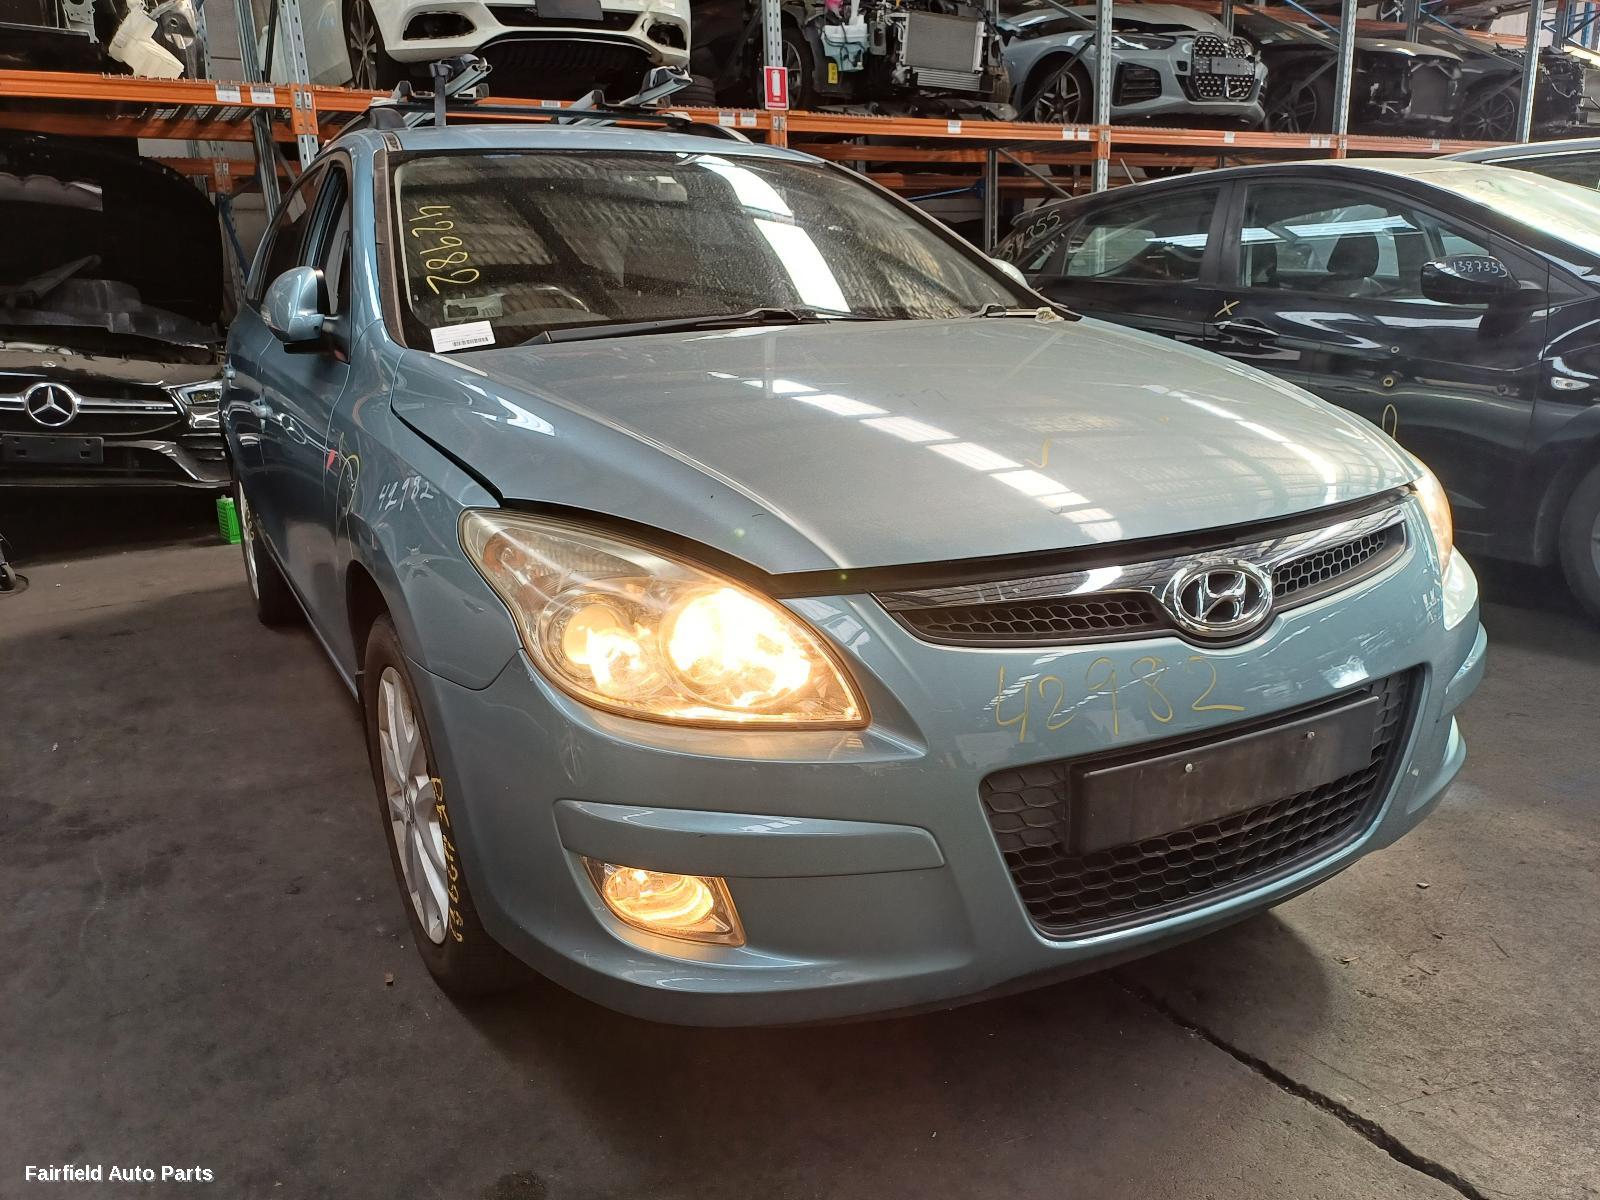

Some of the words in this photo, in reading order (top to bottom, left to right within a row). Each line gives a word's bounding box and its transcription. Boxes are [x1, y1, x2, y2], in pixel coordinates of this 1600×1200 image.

[409, 205, 480, 295] 42982
[1452, 260, 1508, 278] 1387355
[378, 475, 434, 512] 42982
[995, 655, 1247, 743] 42982
